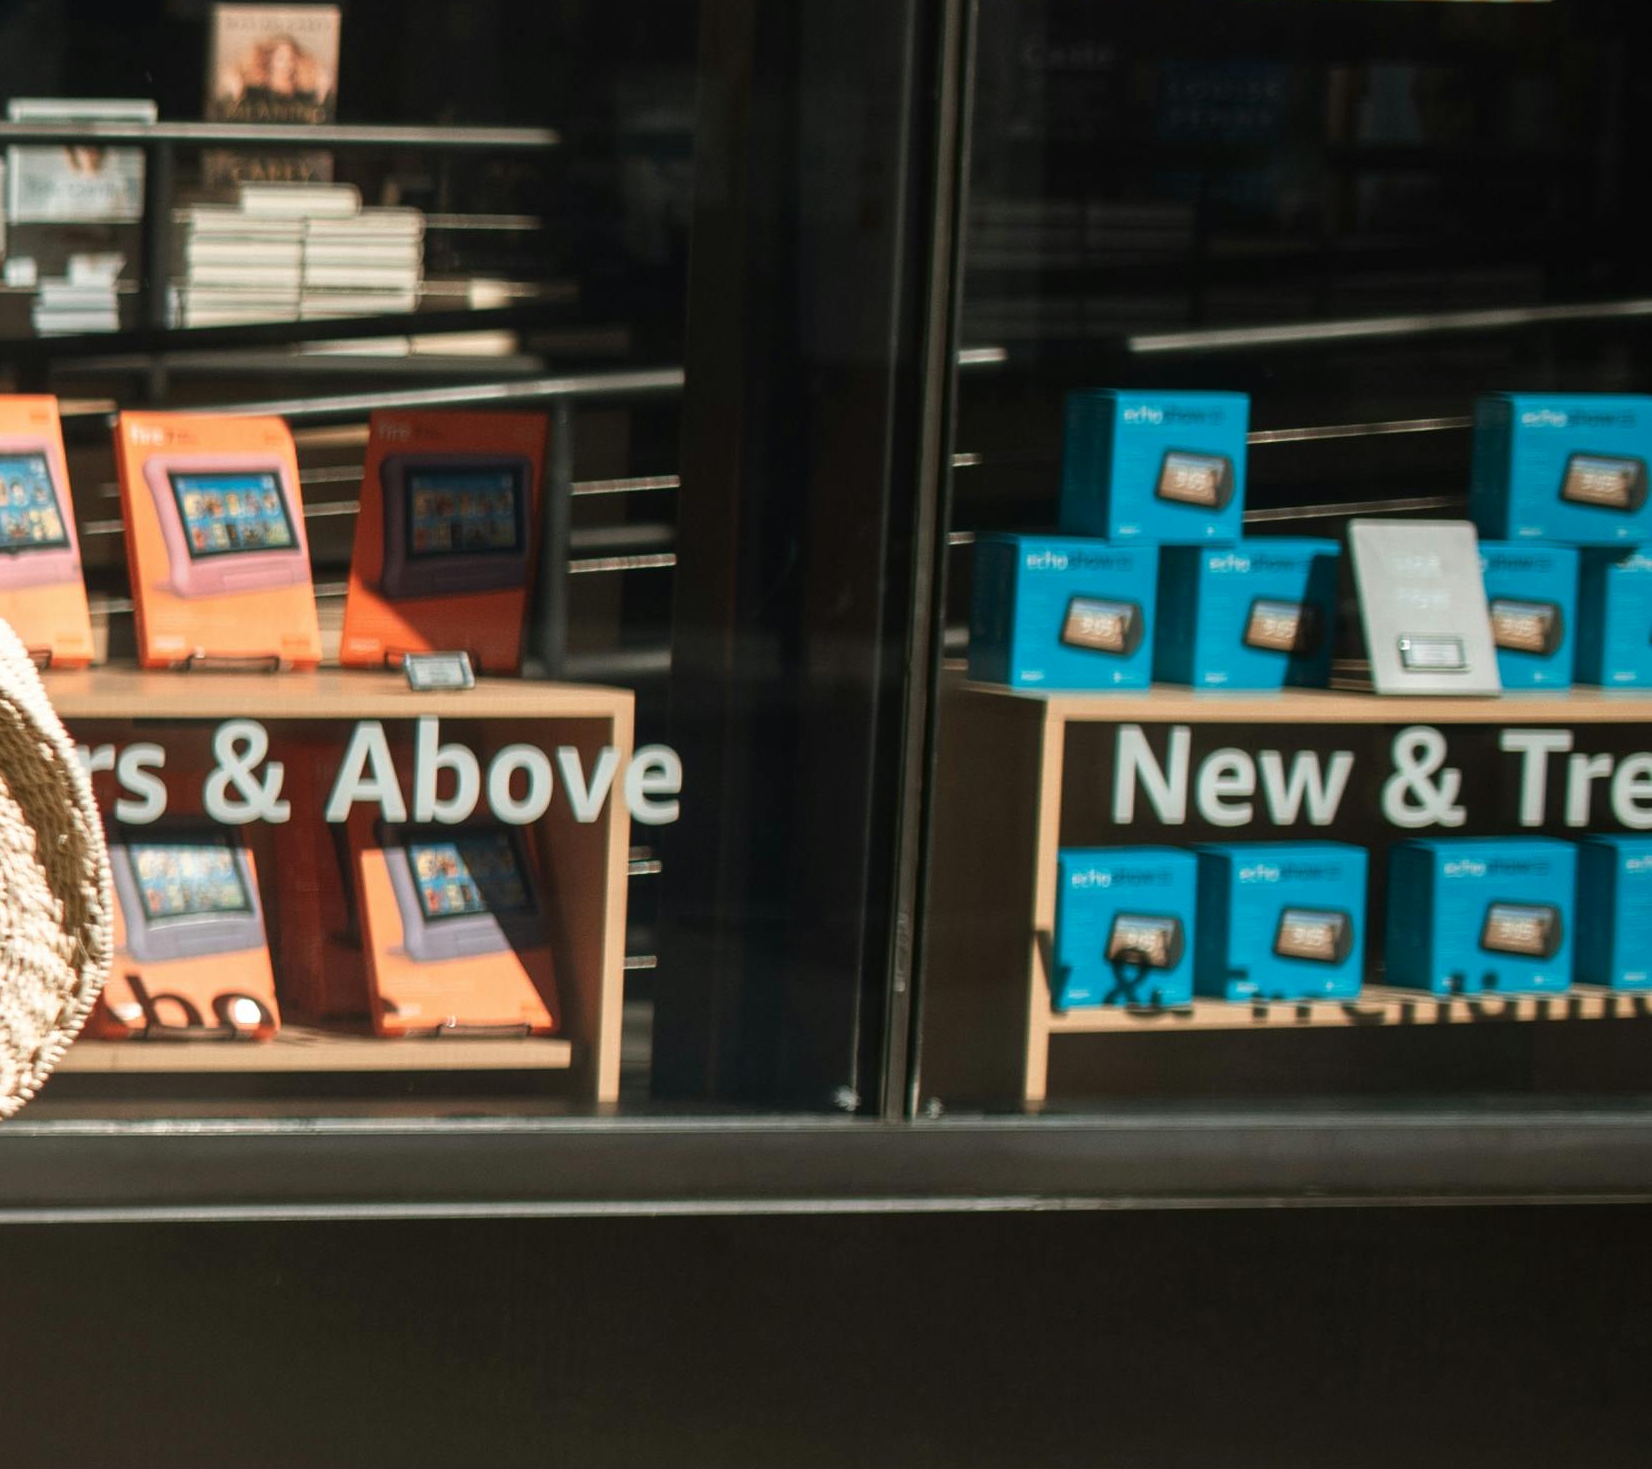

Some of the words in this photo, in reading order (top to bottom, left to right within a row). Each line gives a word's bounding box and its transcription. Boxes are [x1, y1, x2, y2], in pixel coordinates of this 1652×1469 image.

[1124, 405, 1163, 425] echo
[131, 424, 164, 446] fire
[1026, 550, 1069, 571] echo
[1209, 553, 1251, 573] echo
[203, 718, 292, 825] &
[326, 715, 684, 826] Above
[1110, 724, 1355, 827] New
[1381, 725, 1467, 828] &
[1500, 729, 1652, 827] Tre
[1071, 868, 1112, 889] echo
[1239, 863, 1281, 884] echo
